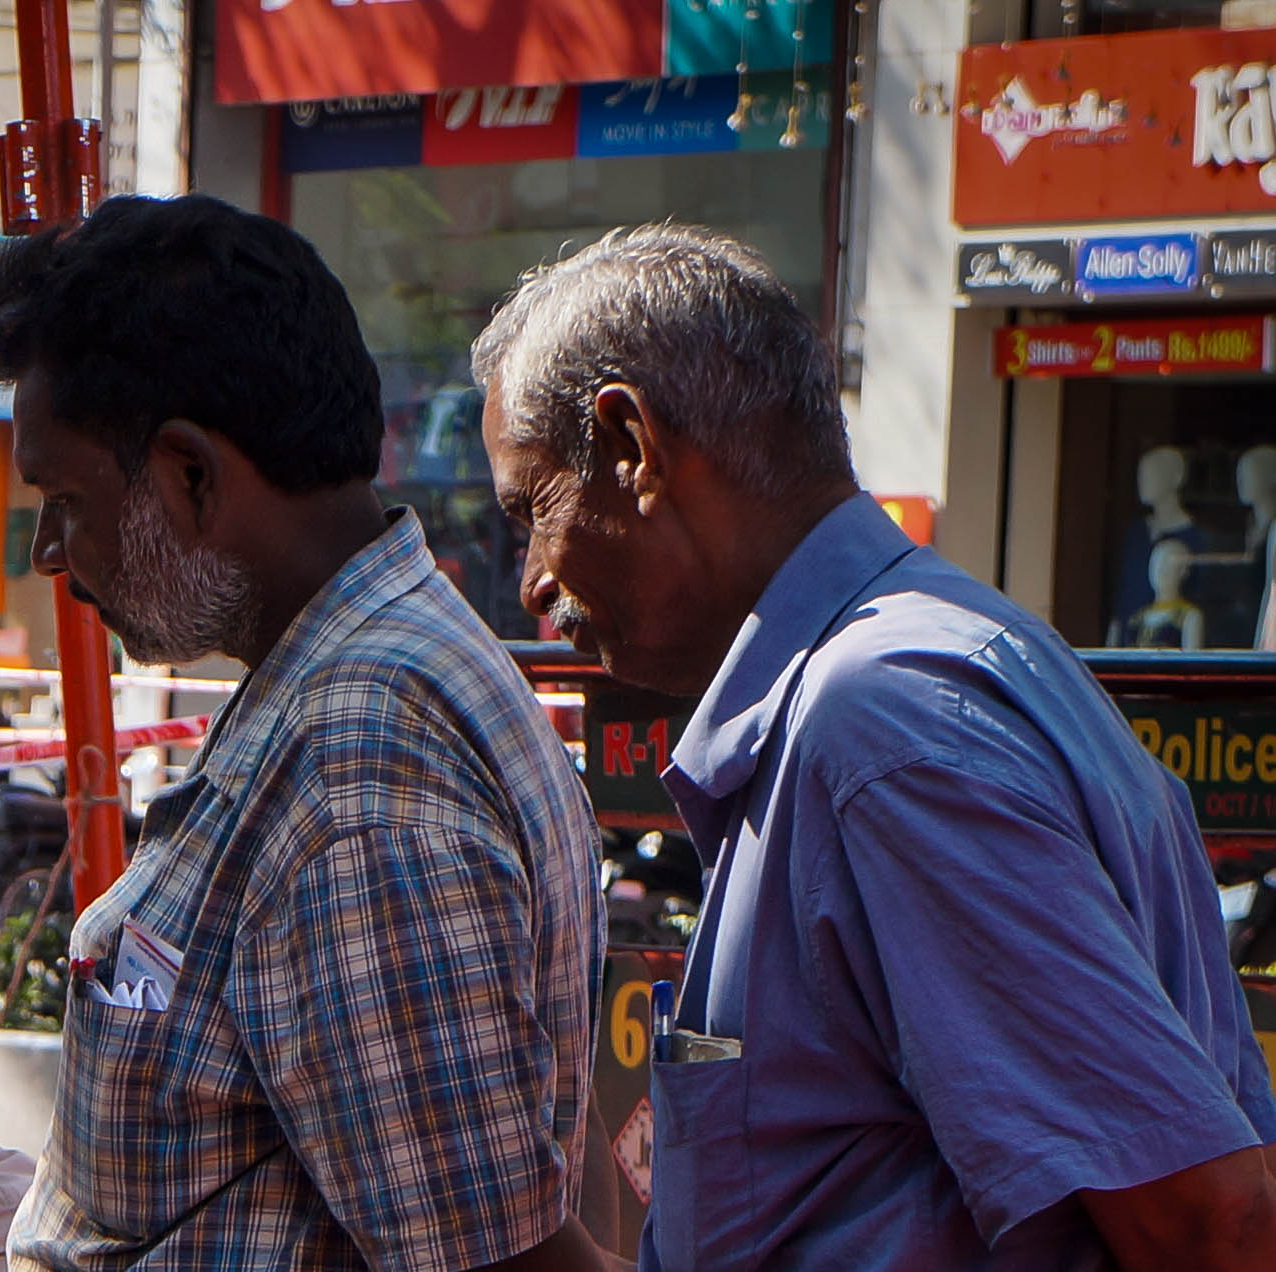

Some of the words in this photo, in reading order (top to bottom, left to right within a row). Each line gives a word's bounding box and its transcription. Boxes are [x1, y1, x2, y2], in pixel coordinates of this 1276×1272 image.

[1084, 245, 1134, 280] Allen
[1137, 241, 1193, 283] Solly
[1007, 330, 1028, 376] 3
[1028, 339, 1077, 366] Shirts
[1091, 325, 1116, 372] 2
[1116, 335, 1164, 363] Pants
[1131, 717, 1276, 783] Police
[1206, 792, 1247, 817] OCT
